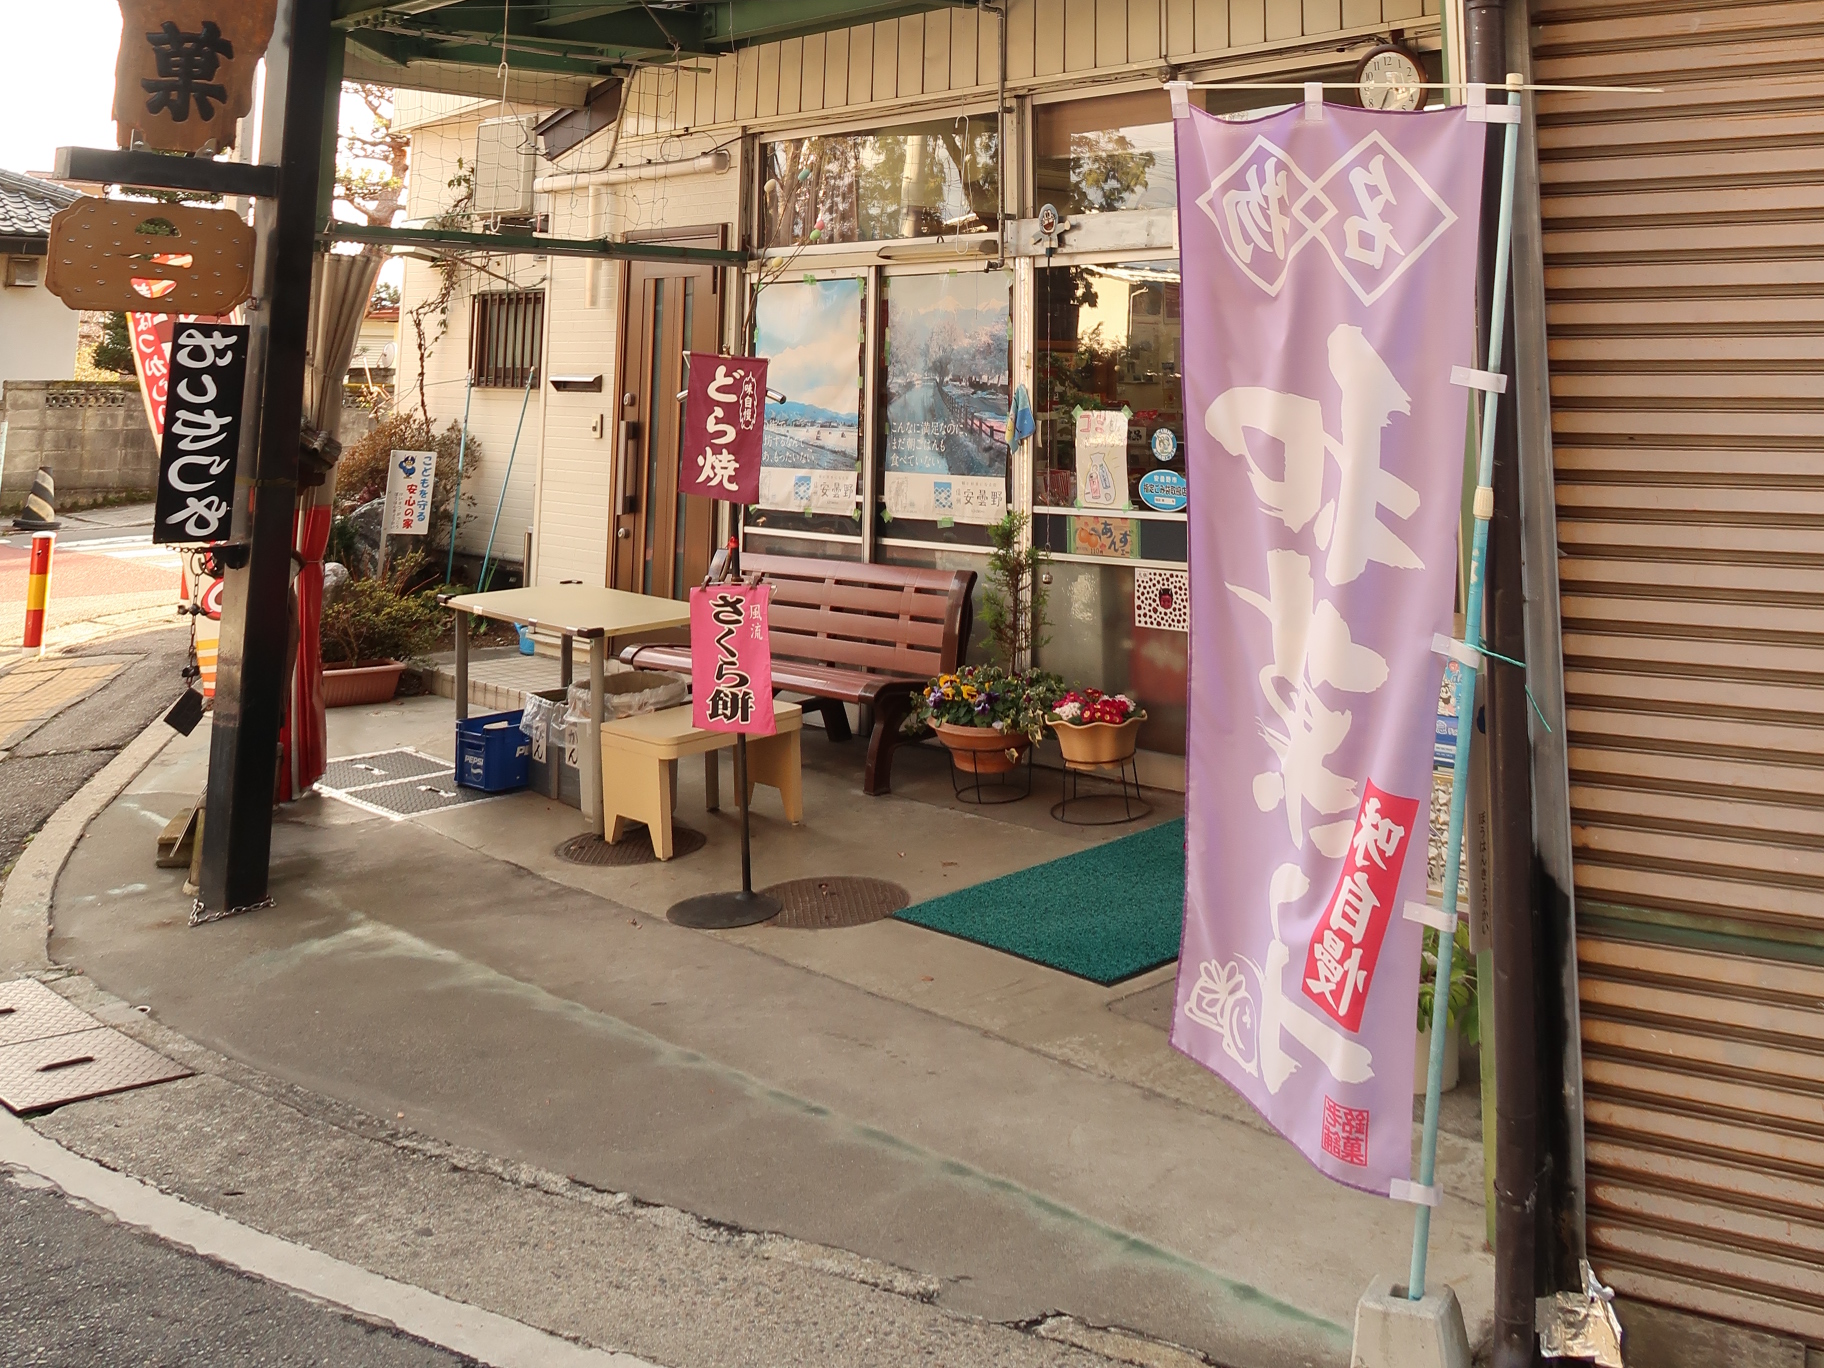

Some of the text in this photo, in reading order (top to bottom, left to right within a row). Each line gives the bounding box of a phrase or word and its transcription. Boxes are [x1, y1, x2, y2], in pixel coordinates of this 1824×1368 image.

[1373, 61, 1380, 71] 11
[1383, 56, 1392, 66] 12
[1365, 71, 1374, 81] 10
[1406, 66, 1412, 77] 2
[1368, 98, 1374, 107] 8
[1408, 94, 1415, 103] 4
[695, 365, 744, 491] どら焼
[417, 455, 433, 522] こどもを守る
[819, 481, 854, 499] 安曇野
[963, 488, 1003, 507] 安曇野
[402, 483, 418, 529] 安心の家
[749, 603, 764, 642] 風流
[705, 592, 756, 725] さくら餅
